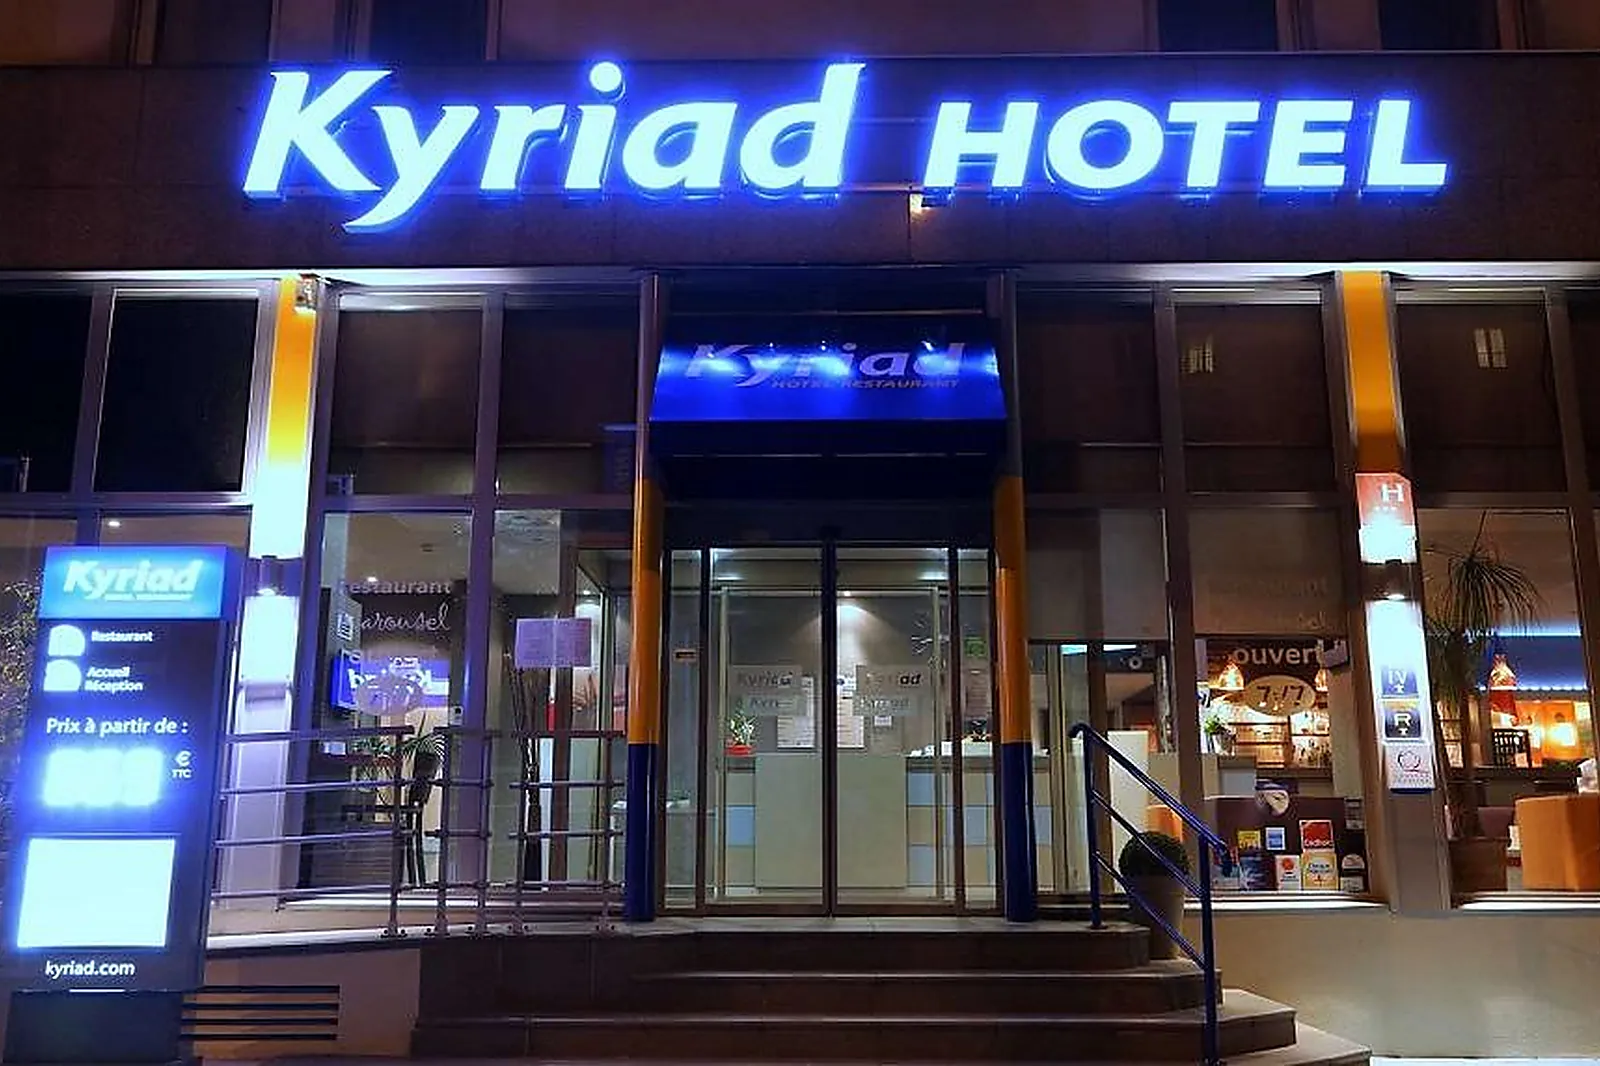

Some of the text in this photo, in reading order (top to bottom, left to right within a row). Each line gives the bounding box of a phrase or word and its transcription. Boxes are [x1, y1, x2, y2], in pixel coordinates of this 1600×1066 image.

[243, 61, 1449, 234] Kyriad HOTEL
[685, 342, 965, 388] Kyriad
[1381, 483, 1404, 502] H
[63, 559, 204, 600] Kyriad
[91, 630, 153, 642] Restaurant
[46, 717, 80, 733] Prix
[84, 717, 96, 733] à
[100, 717, 151, 738] partir
[154, 717, 178, 733] de
[172, 769, 192, 778] TTC
[45, 960, 135, 979] kyriad.com
